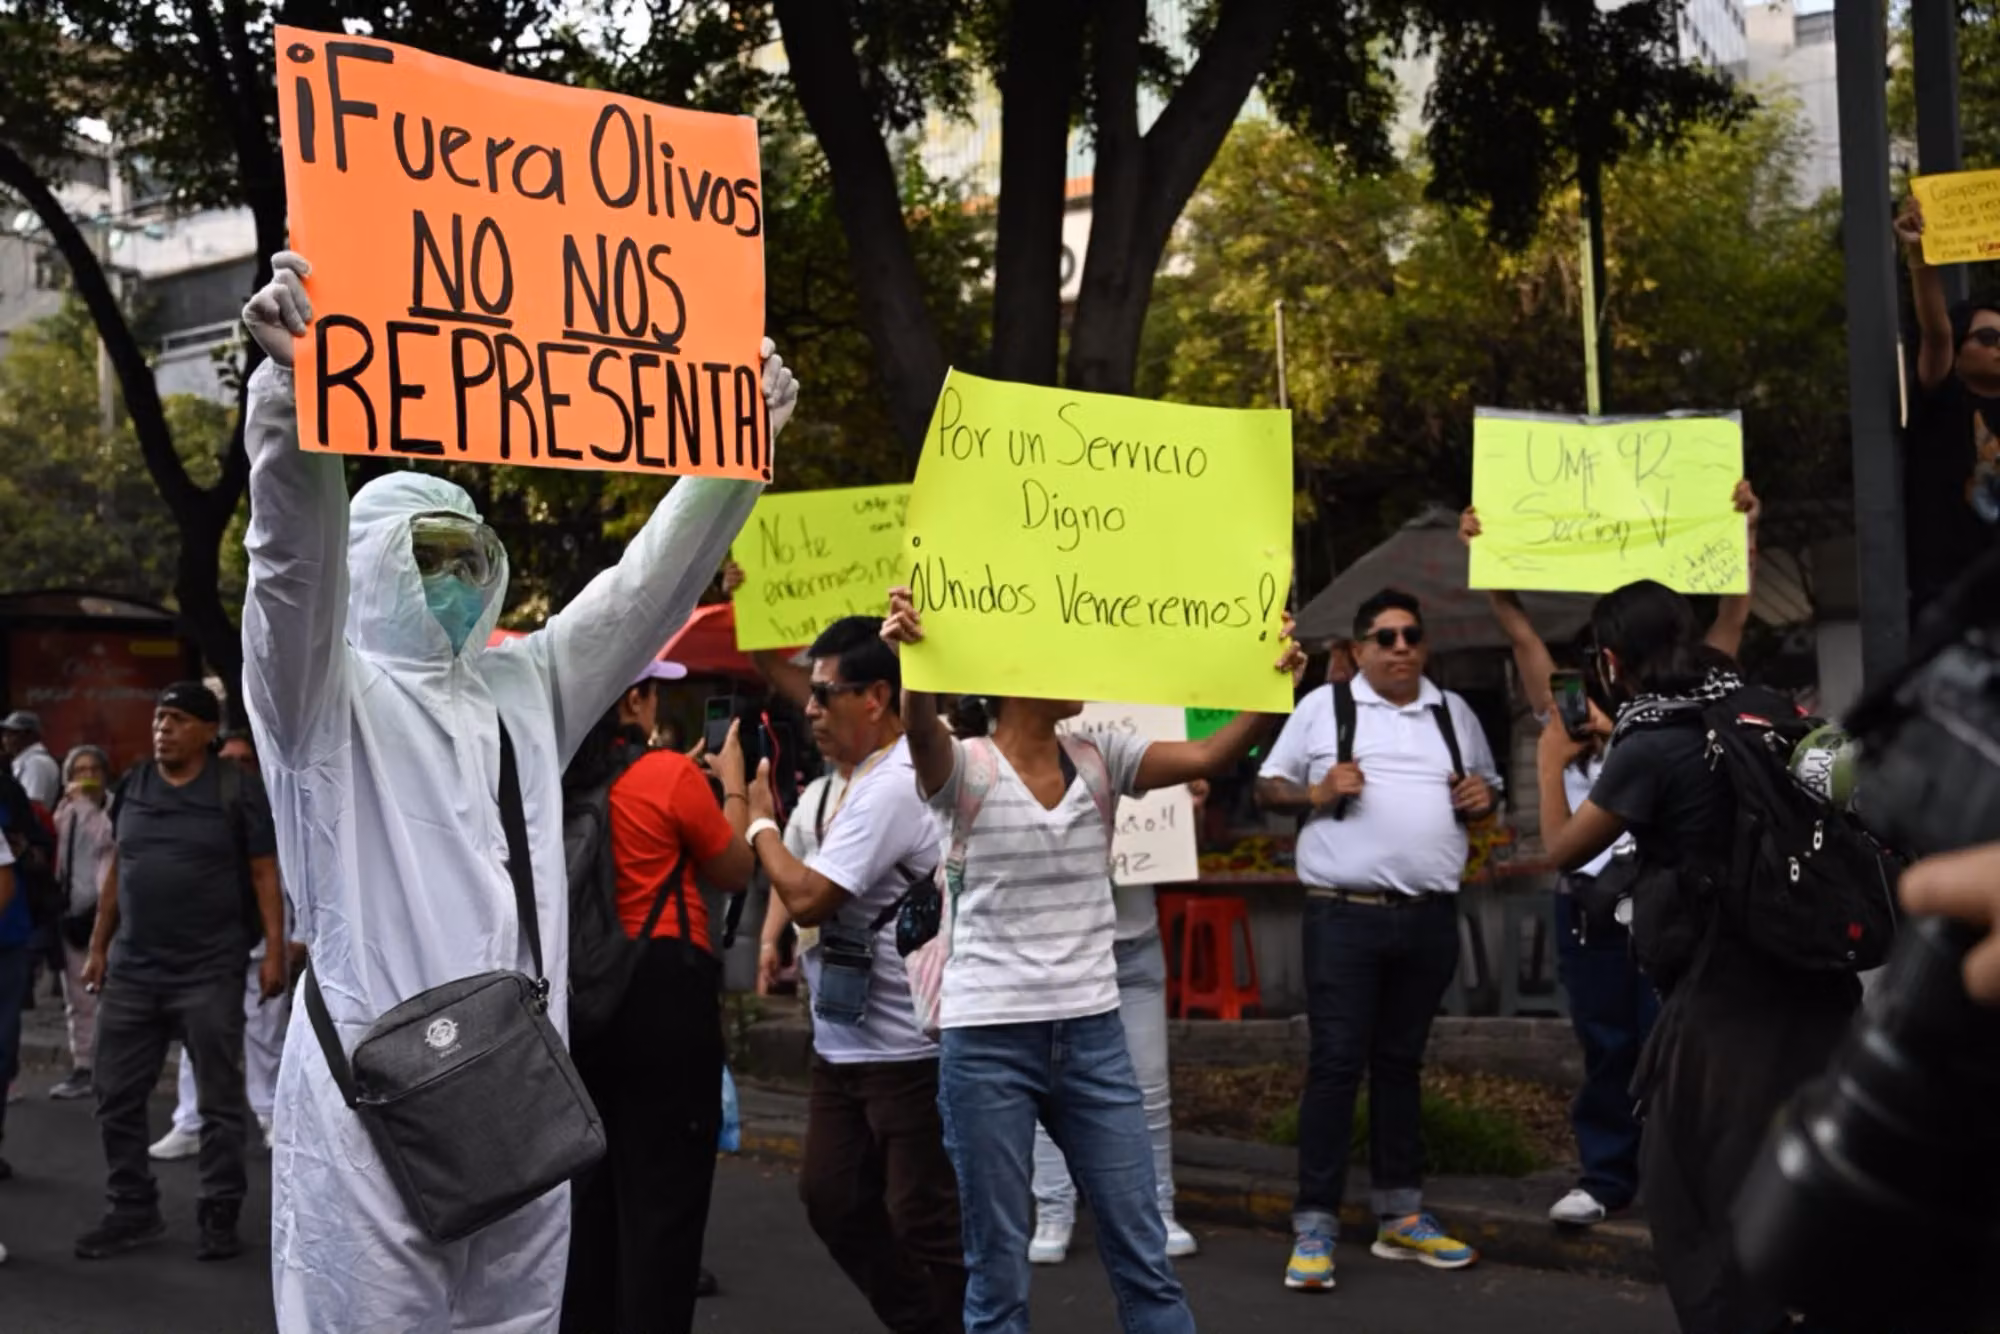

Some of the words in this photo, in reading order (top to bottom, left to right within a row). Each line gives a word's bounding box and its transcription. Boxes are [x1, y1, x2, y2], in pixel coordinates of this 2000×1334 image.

[286, 41, 566, 205] ¡Fuera
[590, 103, 762, 237] Olivos
[411, 209, 513, 316] NO
[563, 234, 687, 347] NOS
[315, 314, 773, 481] REPRESENTA!
[939, 386, 991, 460] Por
[1008, 425, 1046, 466] un
[1057, 402, 1208, 478] Servicio
[1616, 429, 1675, 488] 92
[759, 513, 796, 569] No
[1022, 478, 1127, 552] Digno
[1640, 486, 1671, 549] V
[1056, 572, 1276, 641] Venceremos!
